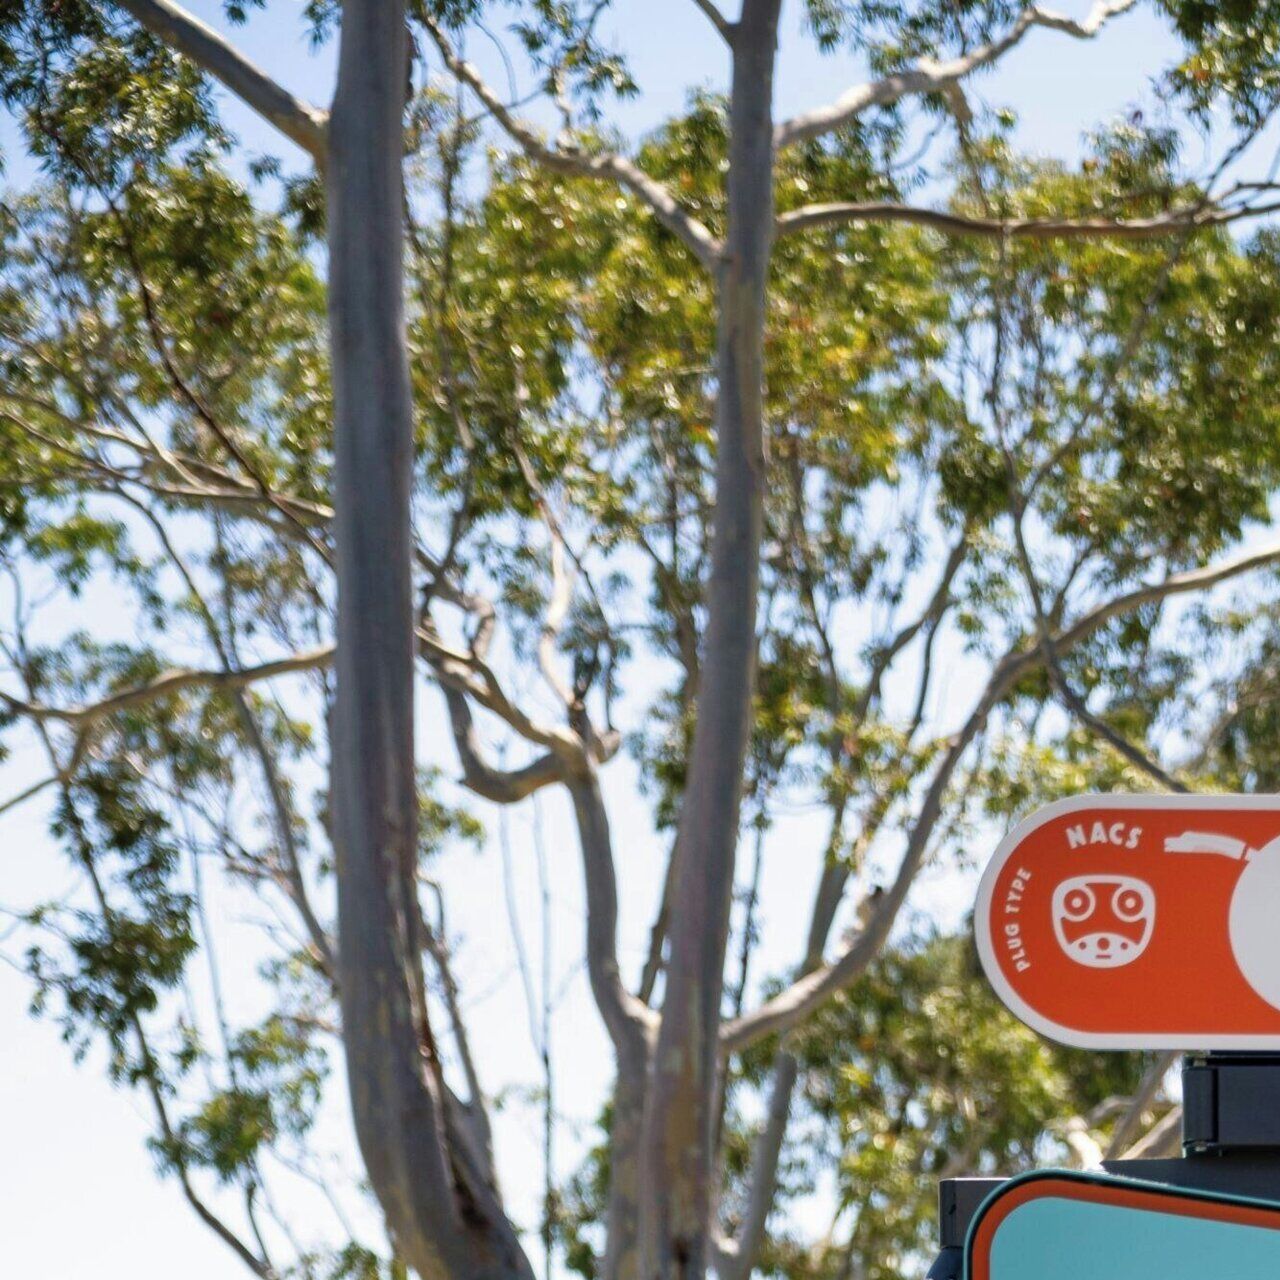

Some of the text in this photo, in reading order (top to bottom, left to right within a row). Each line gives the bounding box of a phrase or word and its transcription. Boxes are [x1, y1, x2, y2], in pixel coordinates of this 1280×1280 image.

[1066, 821, 1142, 849] NACS
[1005, 867, 1032, 972] PLUG TYPE
